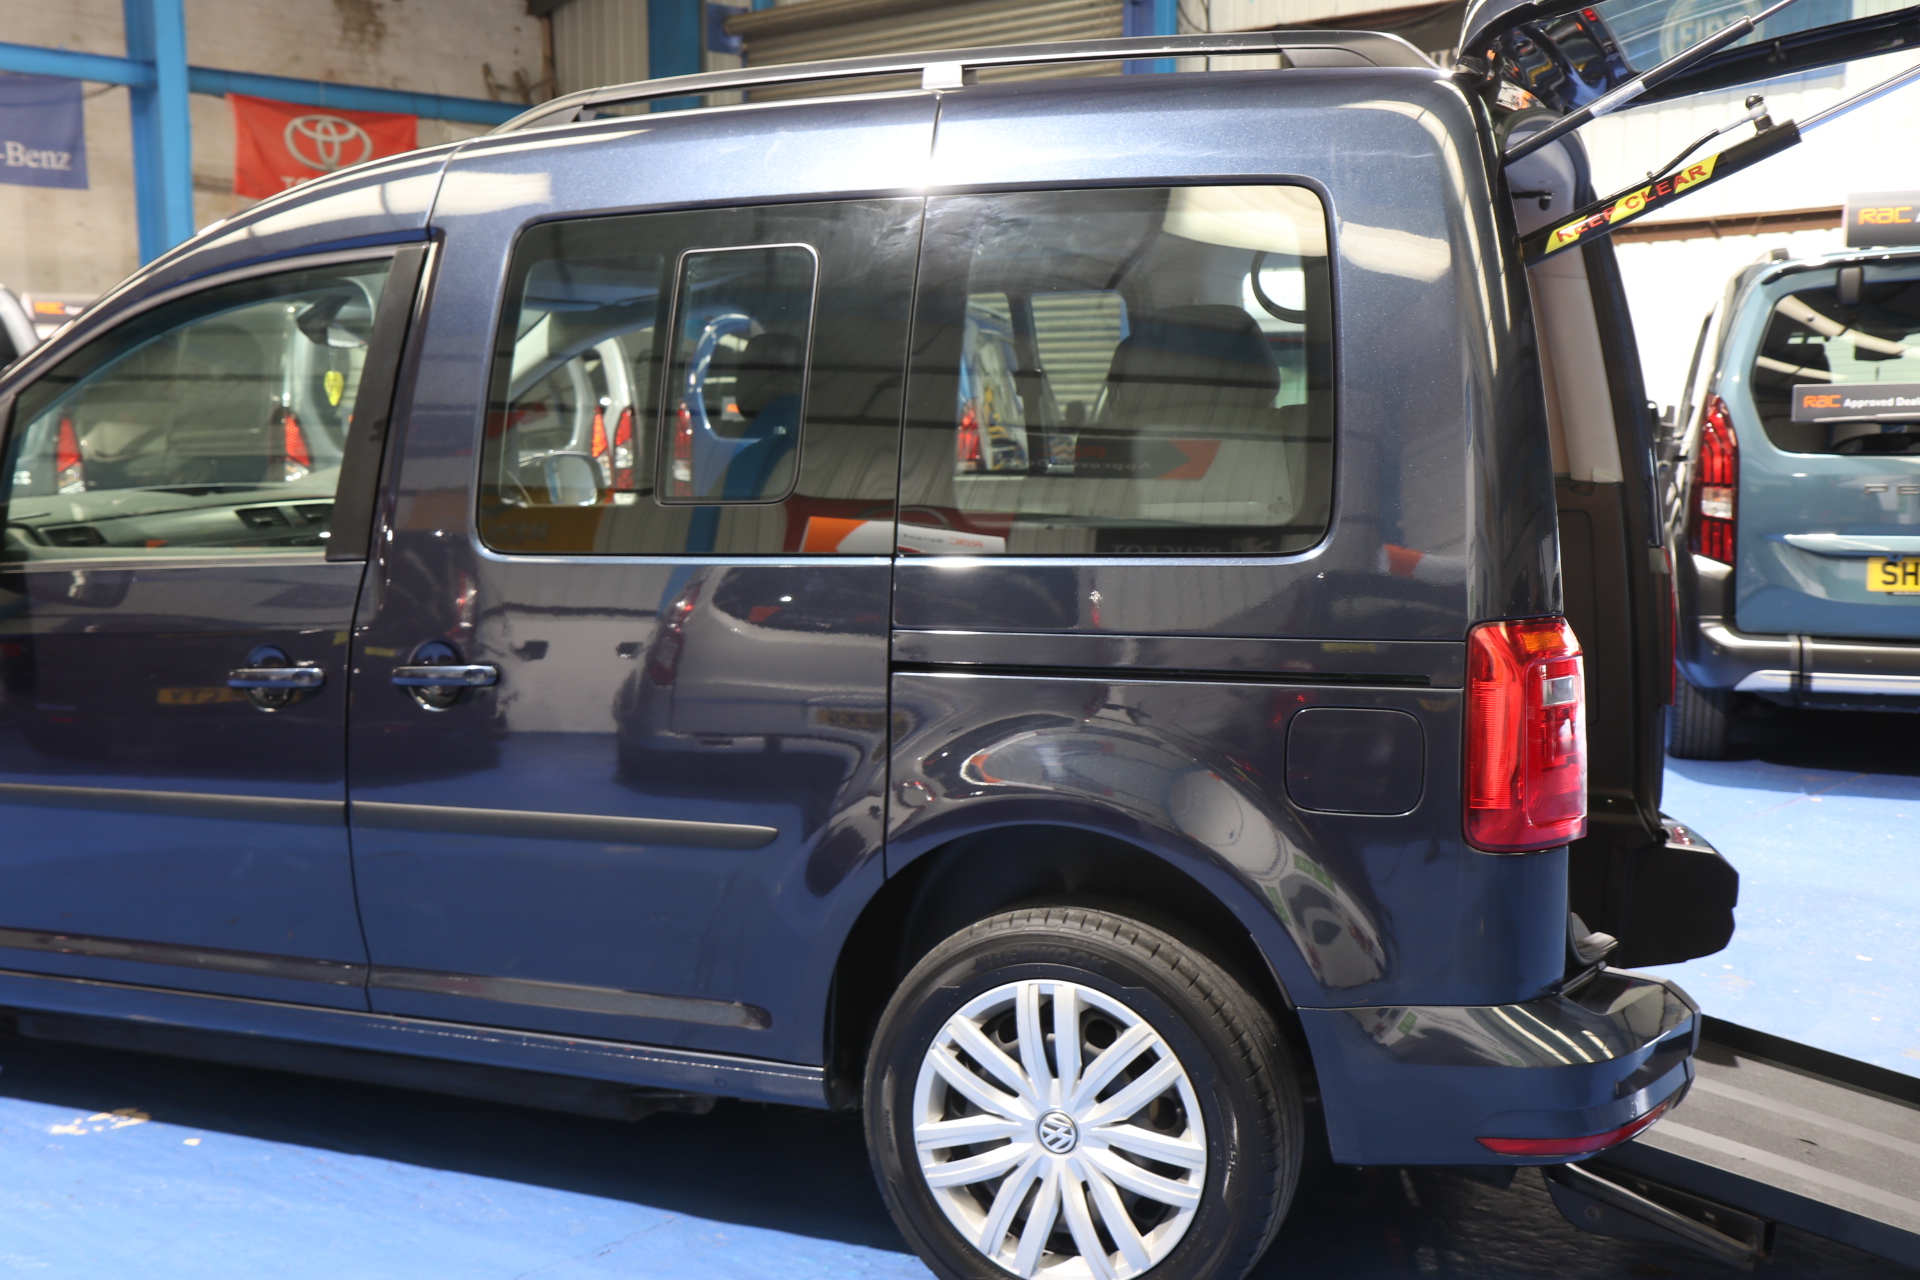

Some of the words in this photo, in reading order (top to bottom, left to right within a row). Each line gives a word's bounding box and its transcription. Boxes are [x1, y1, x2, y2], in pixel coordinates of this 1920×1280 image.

[1556, 206, 1616, 243] KEEP
[1624, 165, 1708, 210] CLEAR
[1843, 397, 1895, 409] Approved
